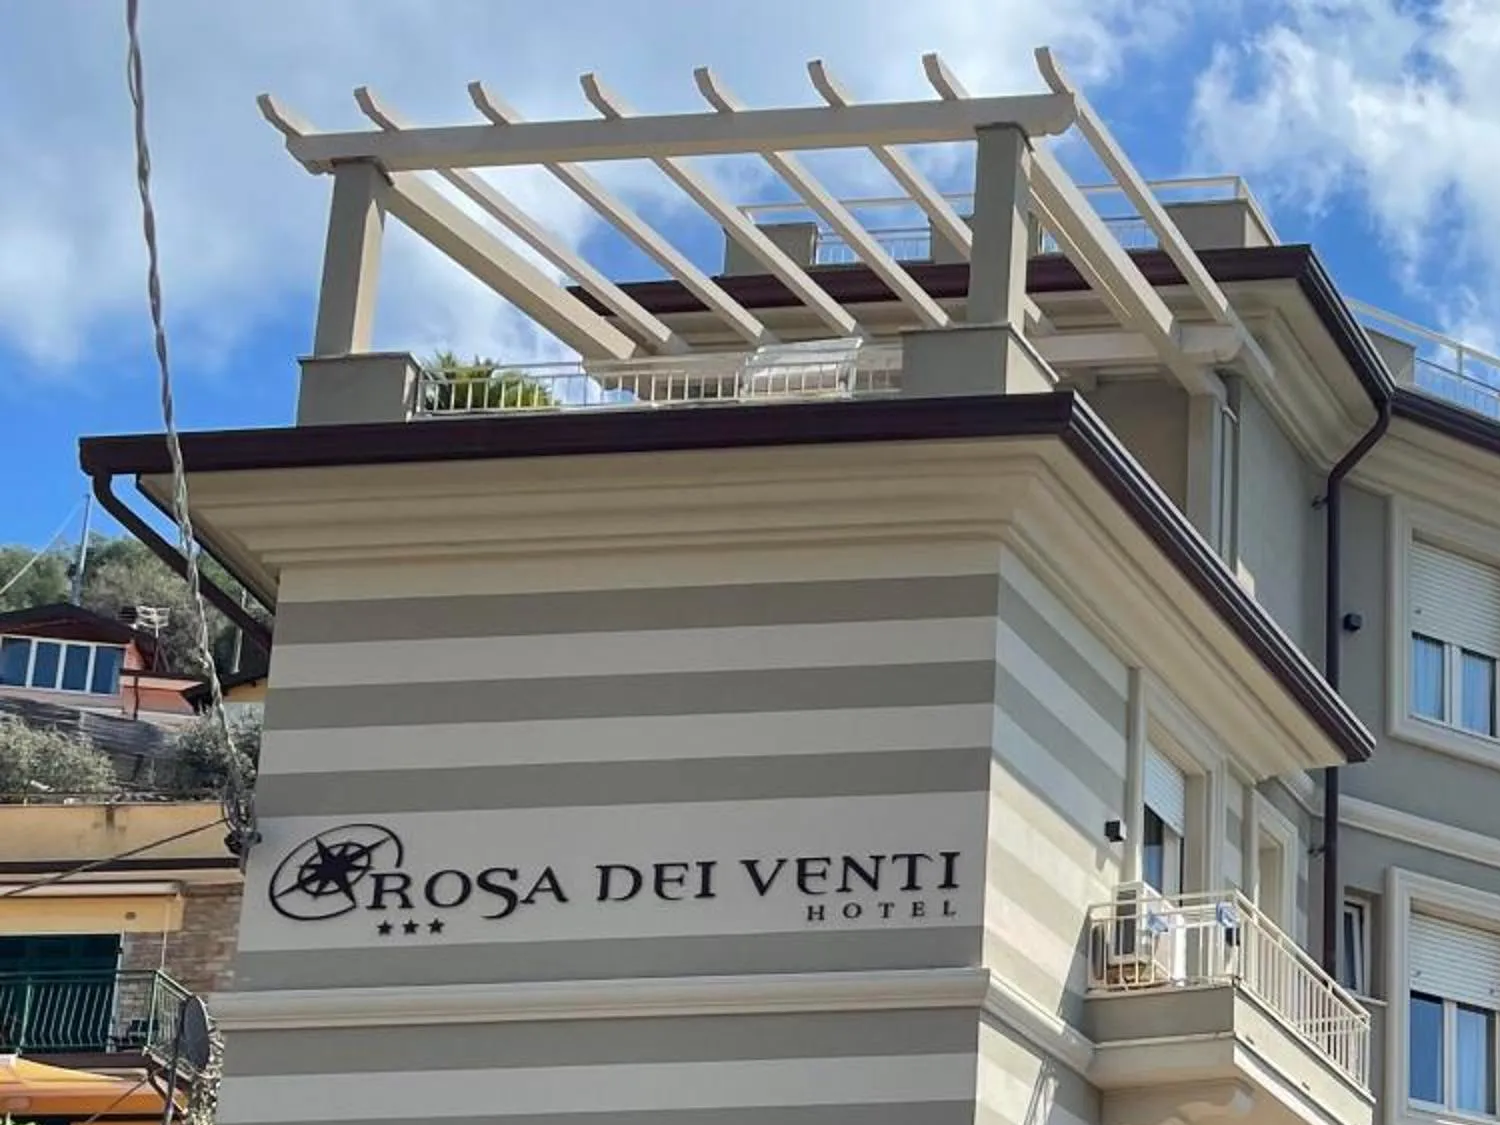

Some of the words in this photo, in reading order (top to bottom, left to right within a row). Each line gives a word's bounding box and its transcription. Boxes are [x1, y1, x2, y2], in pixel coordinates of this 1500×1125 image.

[366, 866, 569, 920] ROSA
[596, 860, 718, 902] DEI
[740, 850, 962, 898] VENTI
[807, 903, 958, 922] HOTEL
